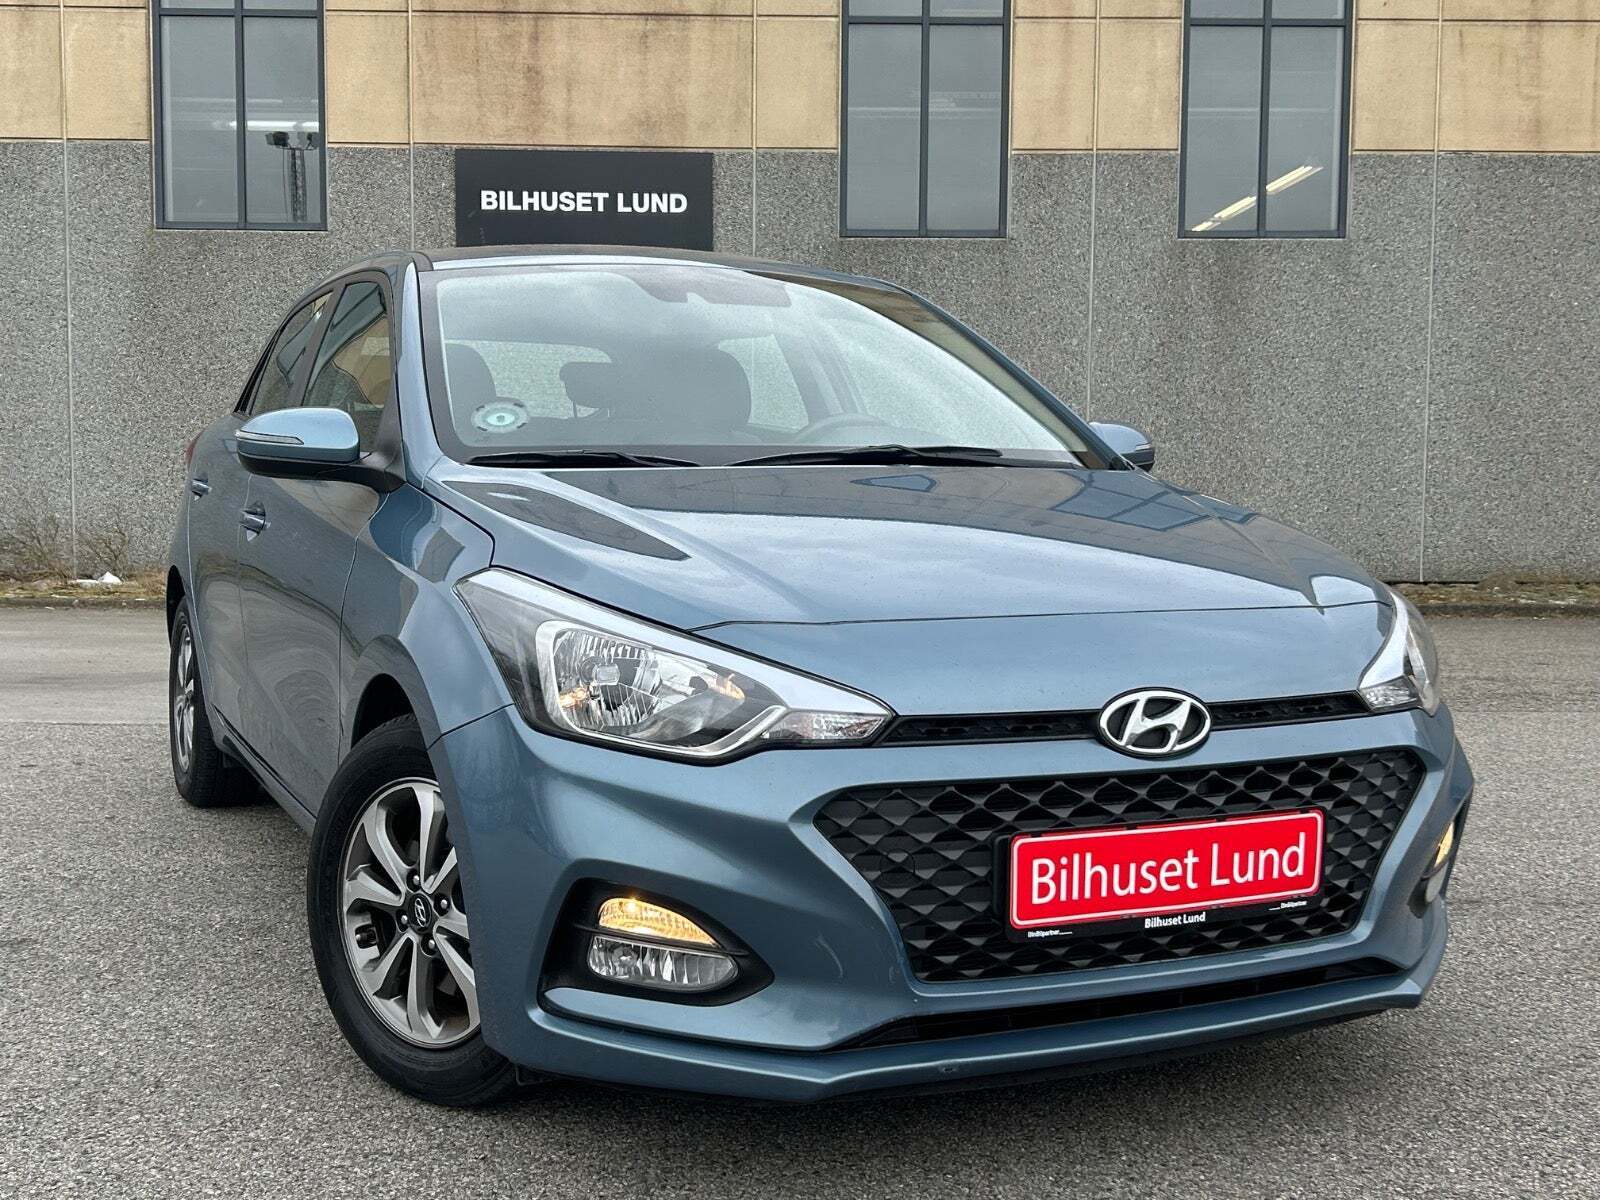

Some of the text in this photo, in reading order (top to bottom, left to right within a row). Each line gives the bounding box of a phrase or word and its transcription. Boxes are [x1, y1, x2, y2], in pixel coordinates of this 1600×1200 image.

[480, 190, 688, 213] BILHUSET LUND
[1031, 831, 1306, 905] Bilhuset Lund
[1144, 911, 1206, 929] Bilhuset Lund
